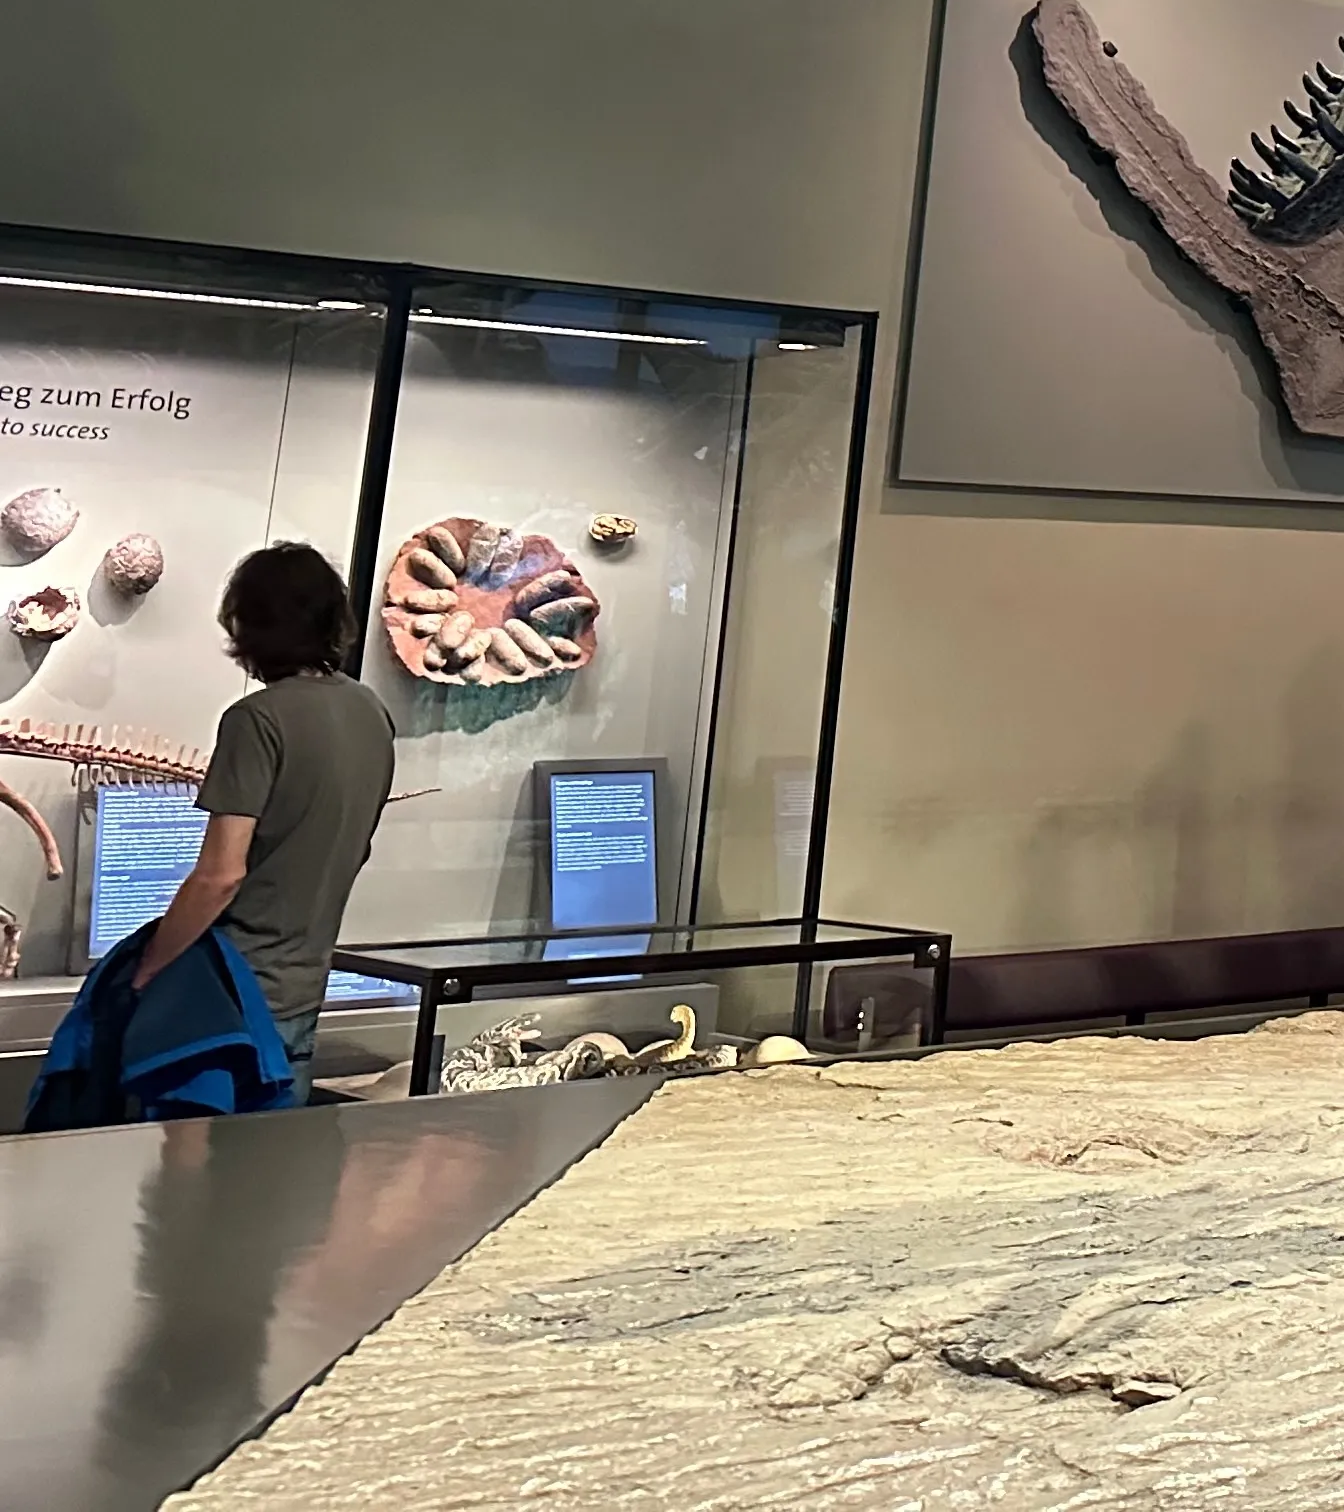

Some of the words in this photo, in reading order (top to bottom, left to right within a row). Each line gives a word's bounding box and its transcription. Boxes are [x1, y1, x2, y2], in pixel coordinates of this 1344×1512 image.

[40, 387, 102, 407] zum
[111, 387, 192, 420] Erfolg
[1, 417, 24, 436] to
[29, 421, 110, 440] success
